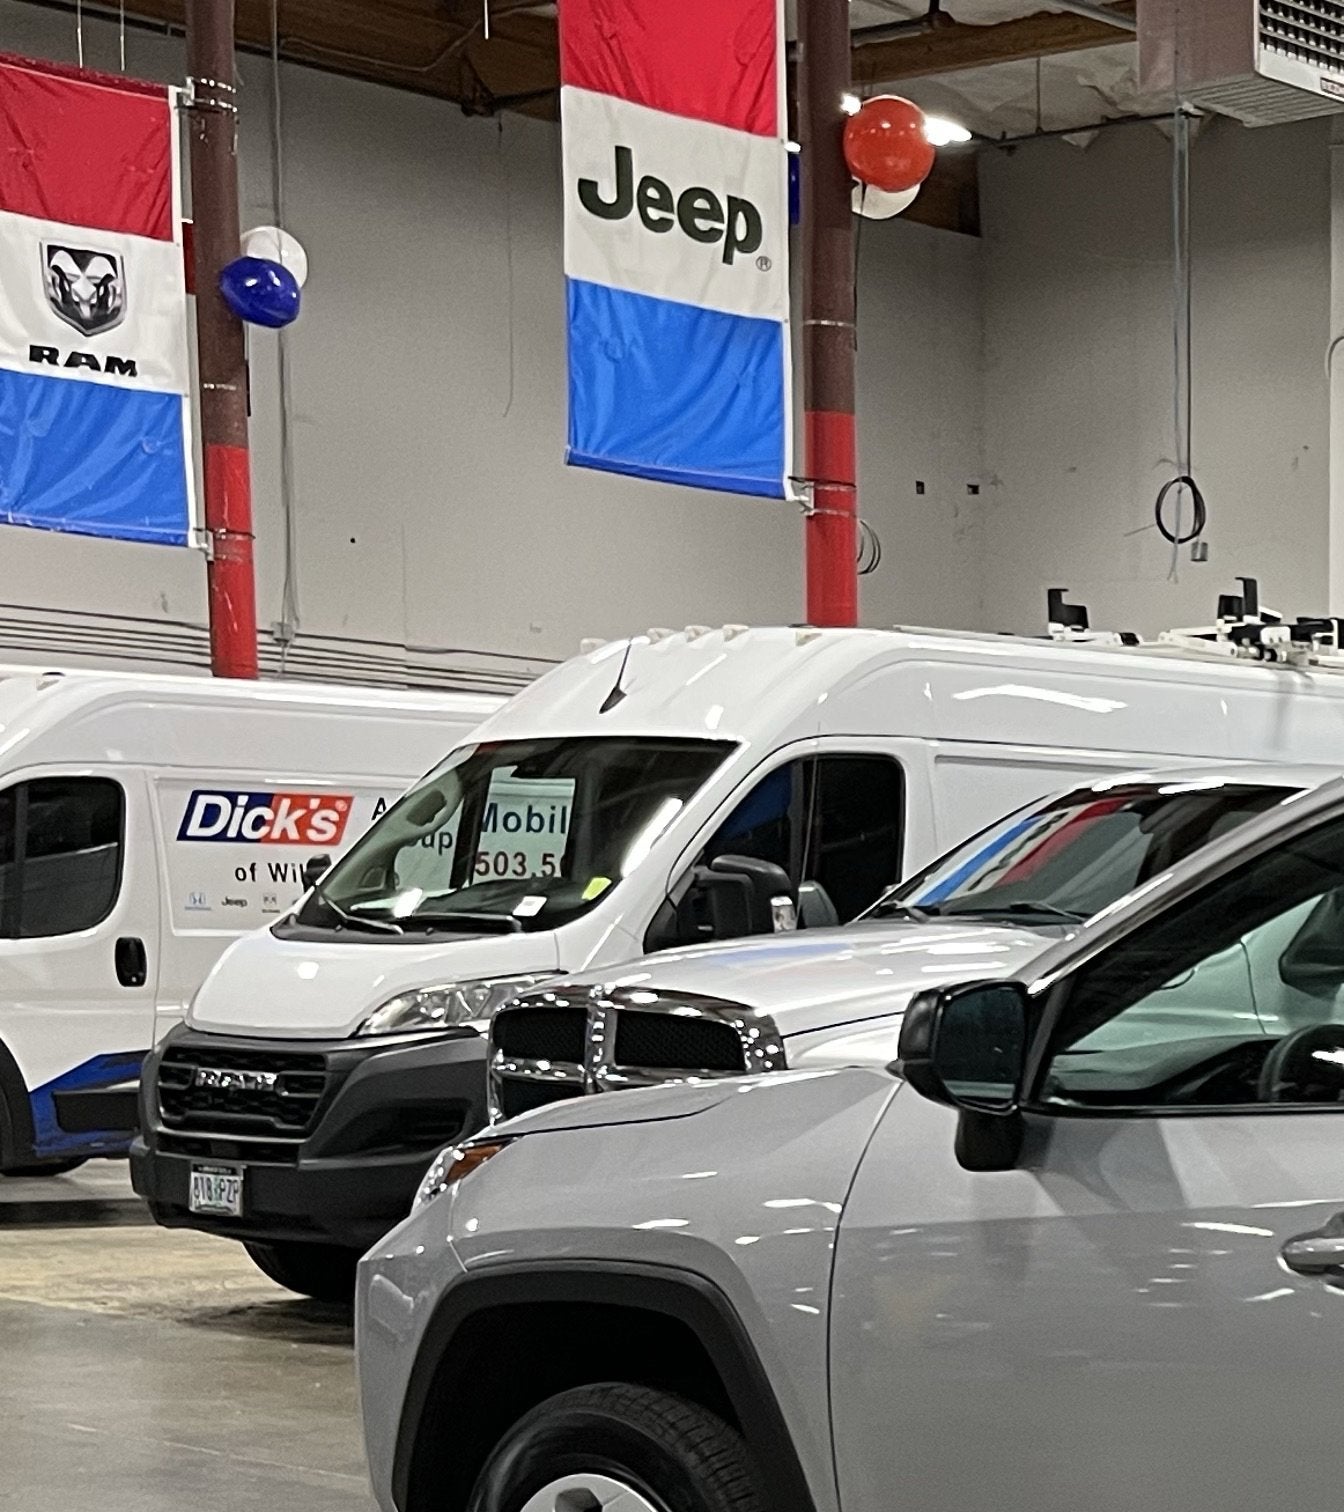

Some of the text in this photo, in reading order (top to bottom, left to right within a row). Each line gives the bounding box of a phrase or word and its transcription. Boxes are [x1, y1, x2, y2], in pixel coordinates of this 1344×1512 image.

[578, 145, 763, 266] Jeep
[29, 344, 138, 378] RAM
[481, 802, 567, 834] Mobil
[234, 862, 257, 882] of
[221, 896, 248, 908] Jeep
